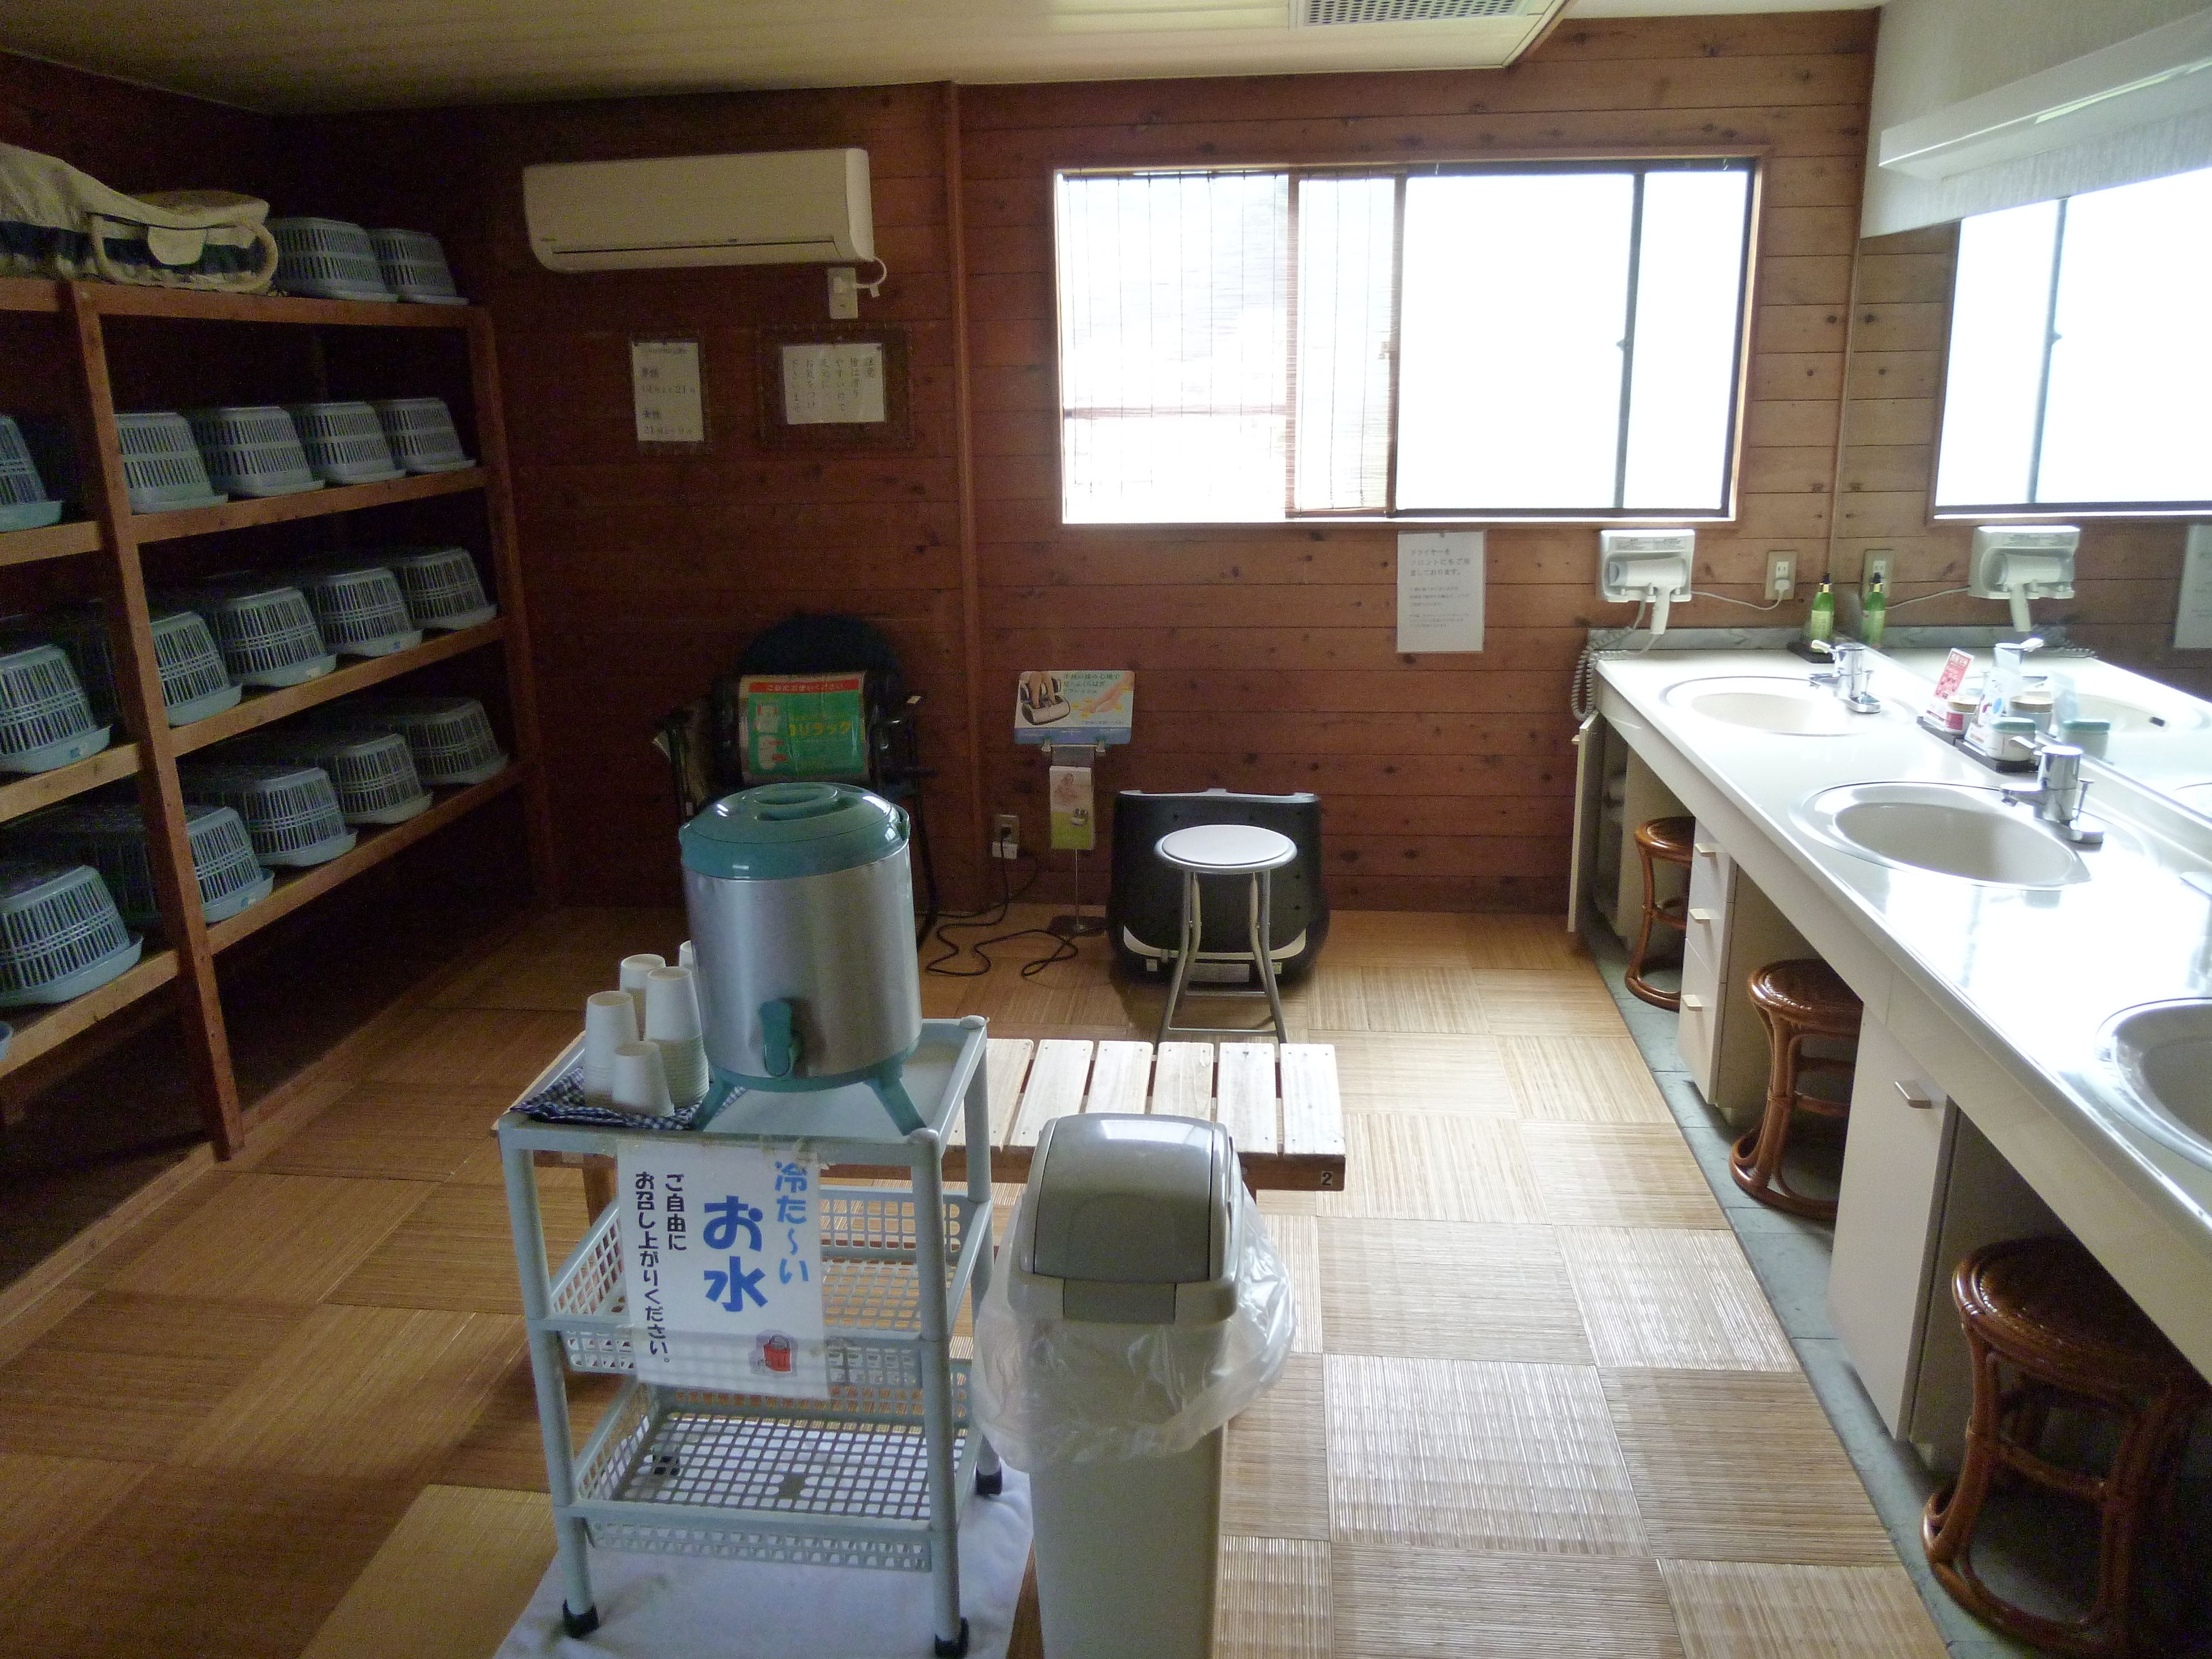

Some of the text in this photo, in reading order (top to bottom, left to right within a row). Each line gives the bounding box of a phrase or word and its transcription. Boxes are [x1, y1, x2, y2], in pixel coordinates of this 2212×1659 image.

[664, 1173, 687, 1252] ご自由に
[1321, 1171, 1332, 1186] 2
[634, 1171, 670, 1363] お召し上がりください。
[702, 1195, 768, 1313] お水
